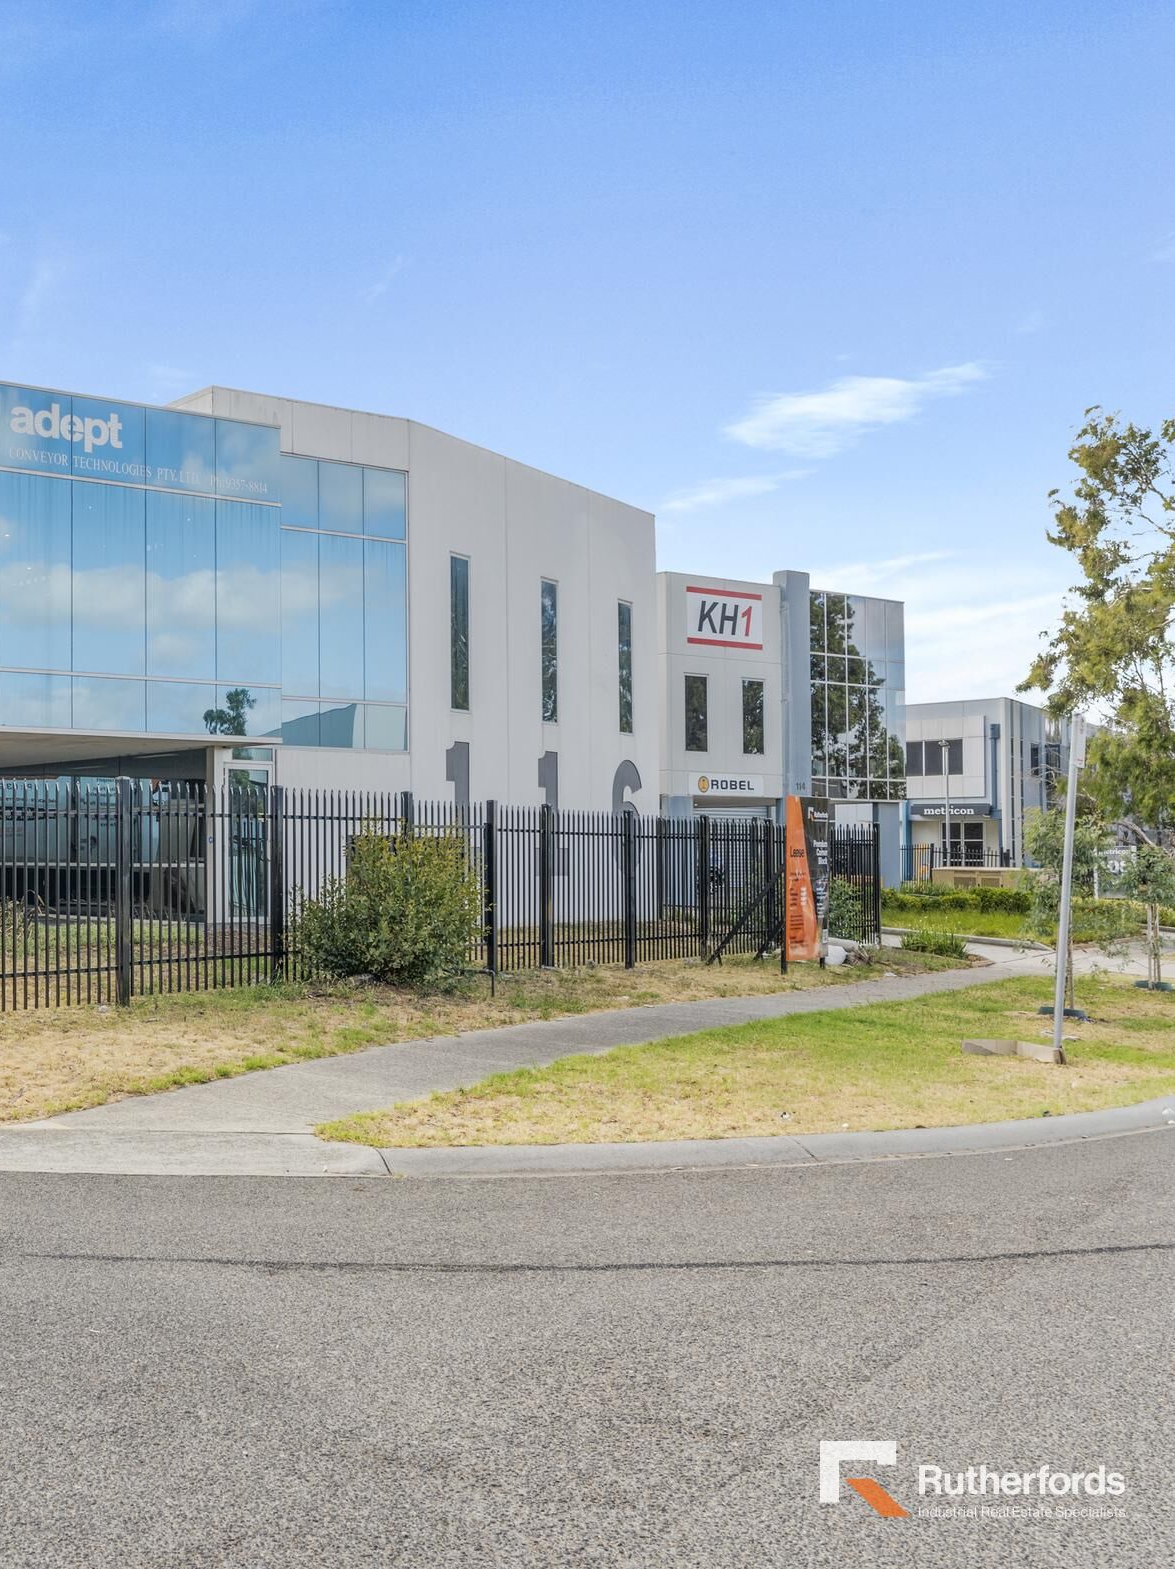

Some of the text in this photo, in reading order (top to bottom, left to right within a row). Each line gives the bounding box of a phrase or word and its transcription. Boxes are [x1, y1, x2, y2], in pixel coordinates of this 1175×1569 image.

[9, 403, 123, 453] adept
[9, 447, 68, 466] CONVEYOR
[72, 455, 152, 478] TECHNOLOGIES
[698, 600, 752, 637] KH1
[711, 779, 754, 790] ROBEL
[924, 805, 974, 815] meticon
